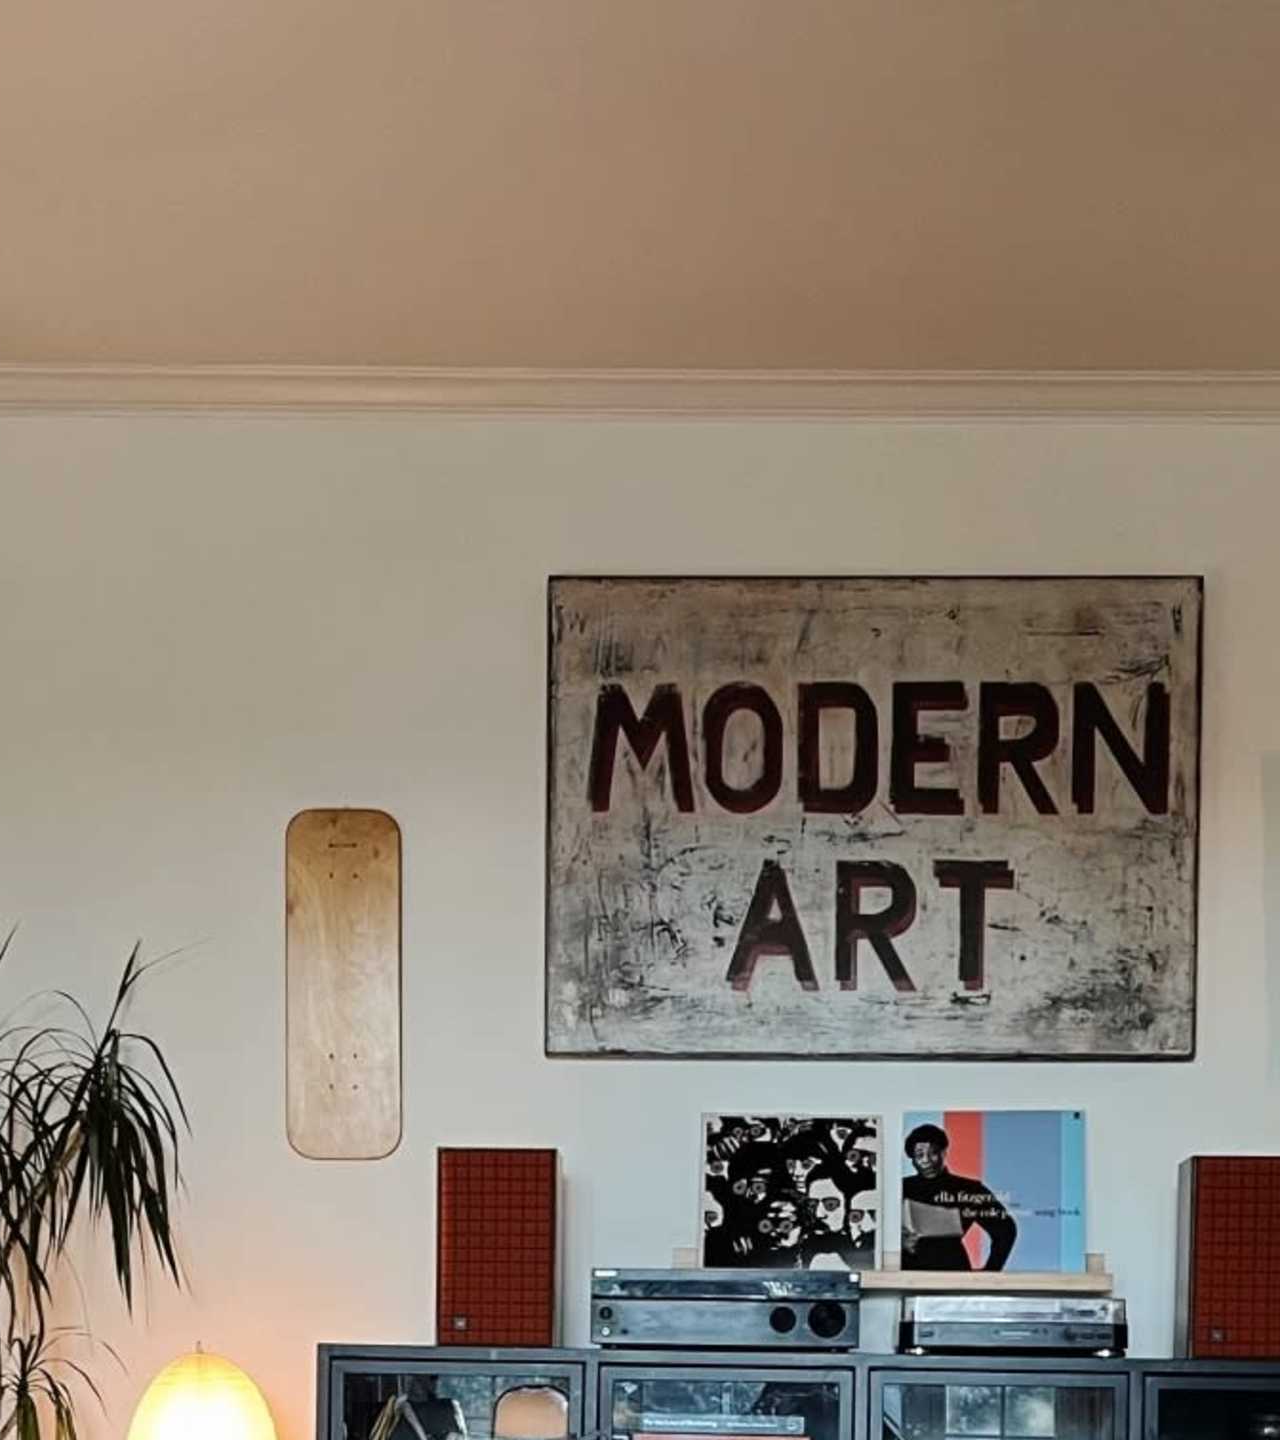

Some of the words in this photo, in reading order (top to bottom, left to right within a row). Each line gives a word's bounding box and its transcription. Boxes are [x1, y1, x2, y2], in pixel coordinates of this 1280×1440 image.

[587, 681, 1171, 816] MODERN
[725, 859, 1015, 992] ART
[934, 1191, 954, 1202] ella
